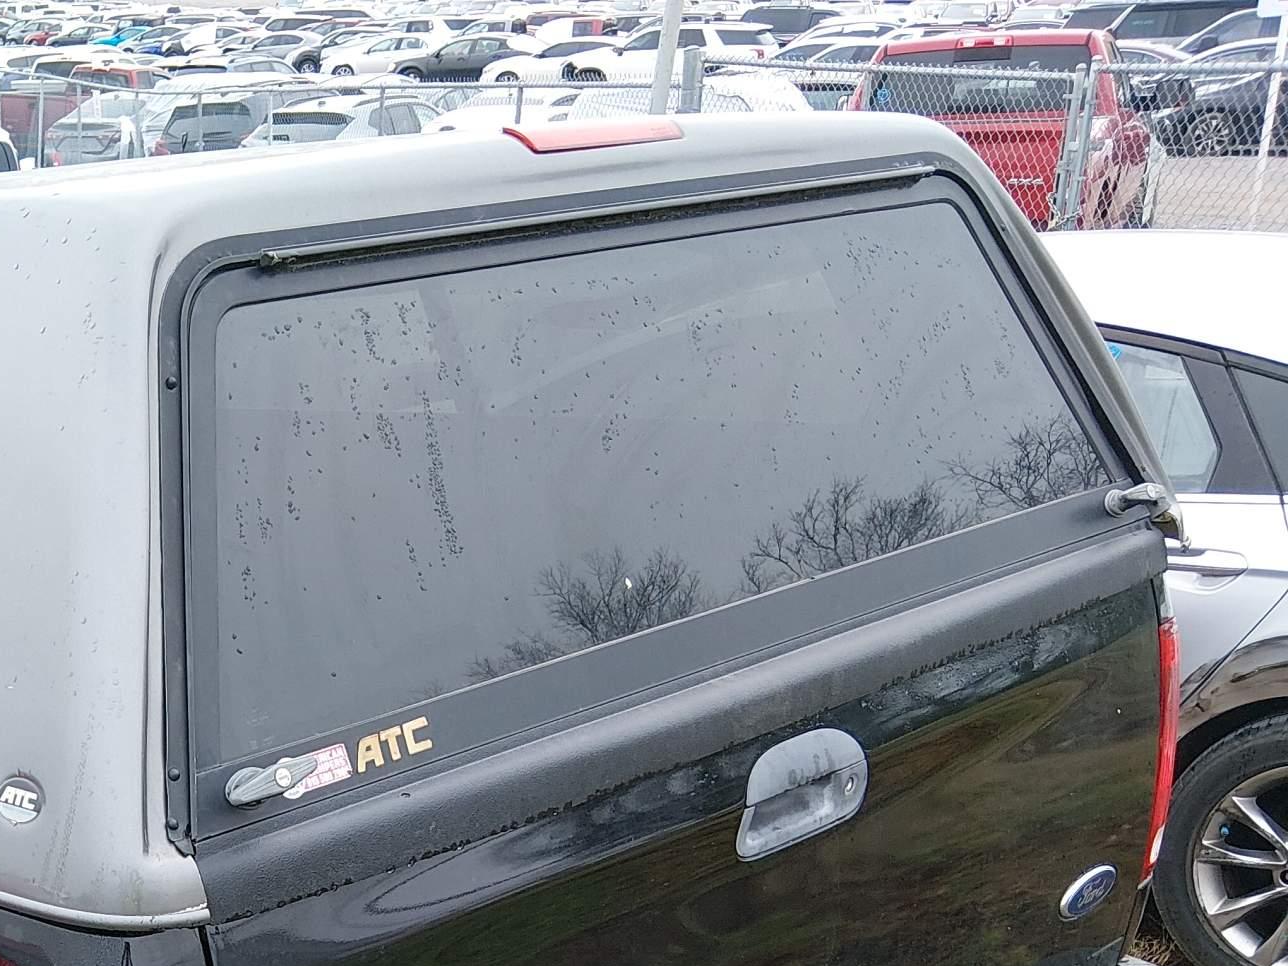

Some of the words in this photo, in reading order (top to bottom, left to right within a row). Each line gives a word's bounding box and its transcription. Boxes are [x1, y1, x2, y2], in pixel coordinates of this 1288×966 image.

[357, 716, 432, 773] ATC
[0, 785, 38, 810] ATC
[1077, 877, 1107, 909] Ford
